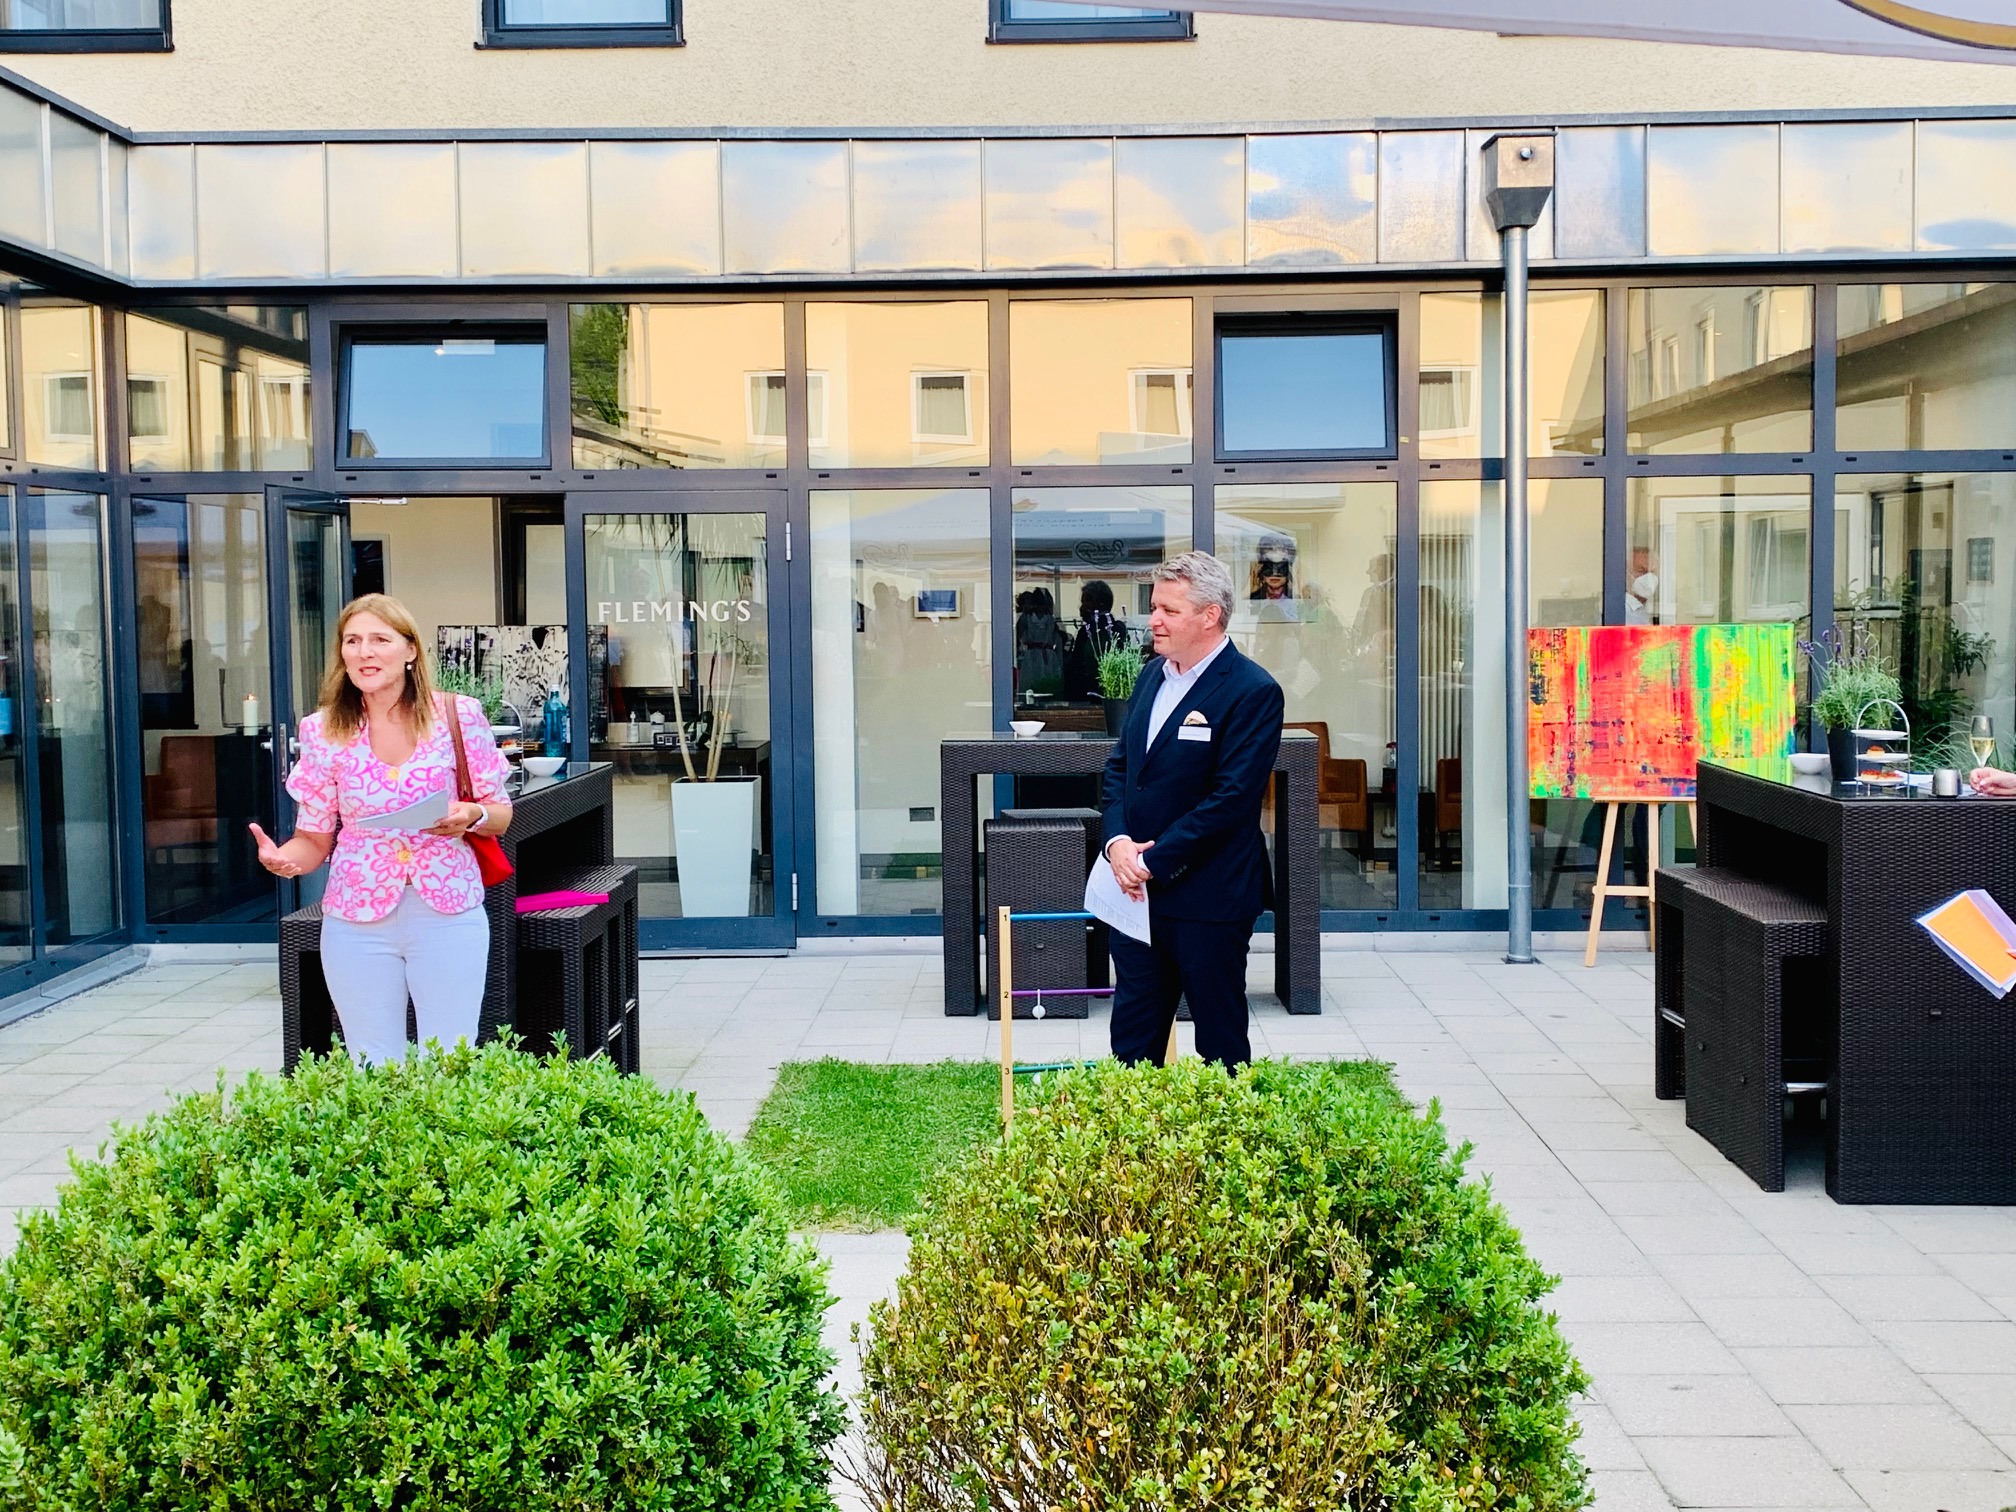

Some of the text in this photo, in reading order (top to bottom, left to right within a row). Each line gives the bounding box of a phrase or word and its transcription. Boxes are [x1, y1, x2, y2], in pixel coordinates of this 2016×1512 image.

[598, 600, 751, 623] FLEMING'S
[1003, 991, 1009, 999] 2
[1004, 1067, 1010, 1075] 3
